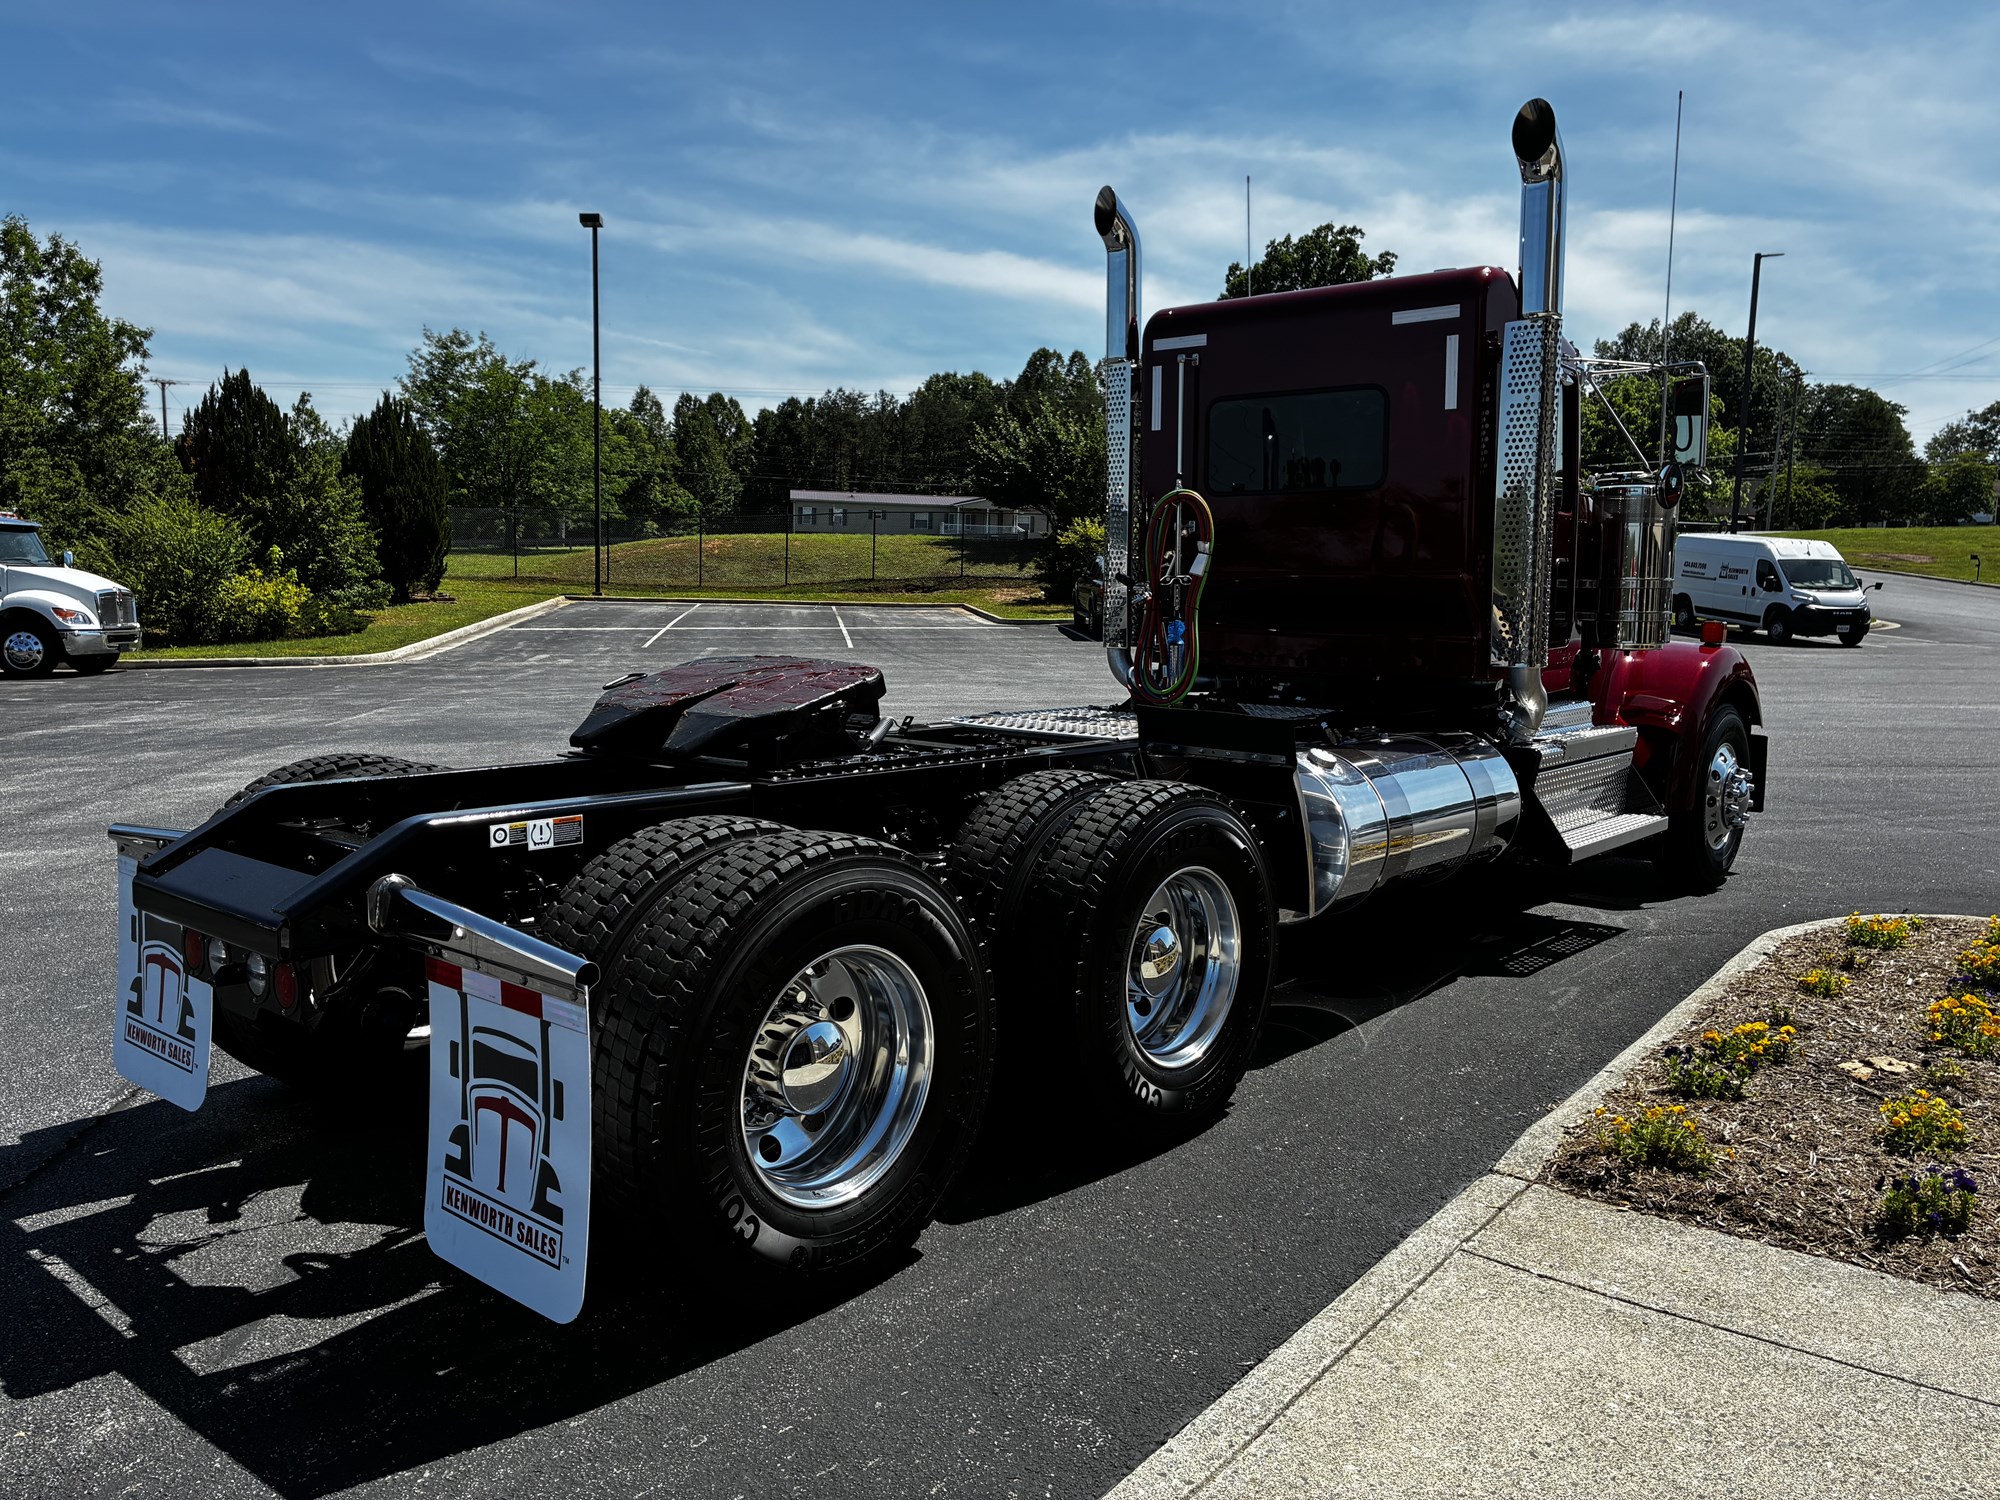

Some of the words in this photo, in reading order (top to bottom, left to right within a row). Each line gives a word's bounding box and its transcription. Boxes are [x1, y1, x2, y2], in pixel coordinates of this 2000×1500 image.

[127, 1022, 167, 1055] KENWORTH
[167, 1042, 191, 1067] SALES
[446, 1185, 513, 1236] KENWORTH
[516, 1222, 558, 1261] SALES
[562, 1255, 570, 1264] TM
